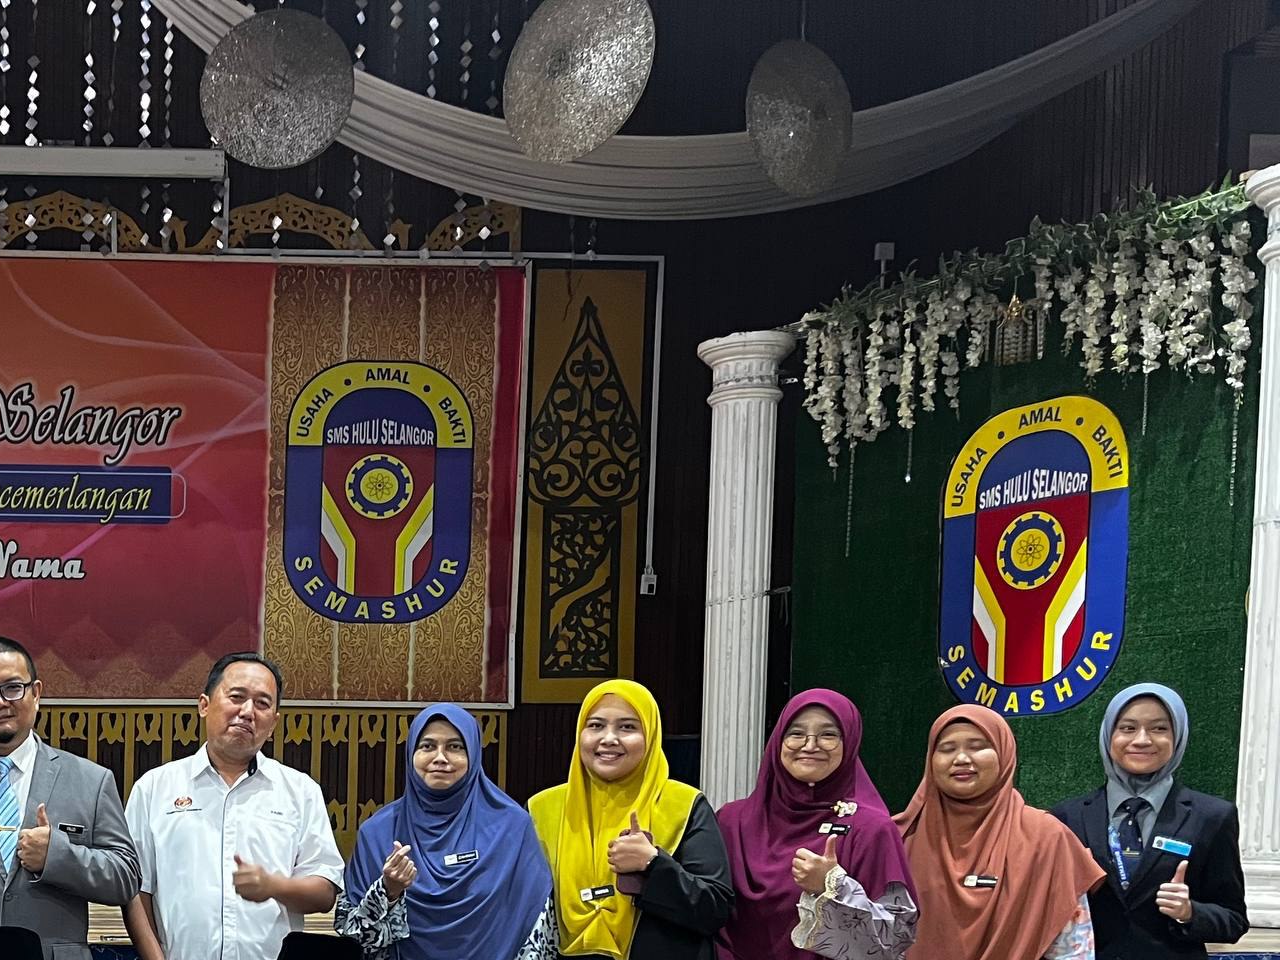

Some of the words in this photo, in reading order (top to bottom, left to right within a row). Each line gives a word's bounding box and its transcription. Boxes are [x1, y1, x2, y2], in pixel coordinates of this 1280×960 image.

[296, 387, 335, 438] USAHA
[365, 368, 411, 385] AMAL
[438, 396, 467, 444] BAKTI
[326, 425, 351, 446] SMS
[351, 420, 380, 446] HULU
[380, 418, 435, 446] SELANGOR
[951, 447, 988, 508] USAHA
[1018, 406, 1063, 430] AMAL
[1091, 424, 1123, 479] BAKTI
[979, 486, 1002, 510] SMS
[1003, 473, 1032, 504] HULU
[1031, 467, 1089, 499] SELANGOR
[294, 555, 460, 620] SEMASHUR
[948, 630, 1114, 714] SEMASHUR
